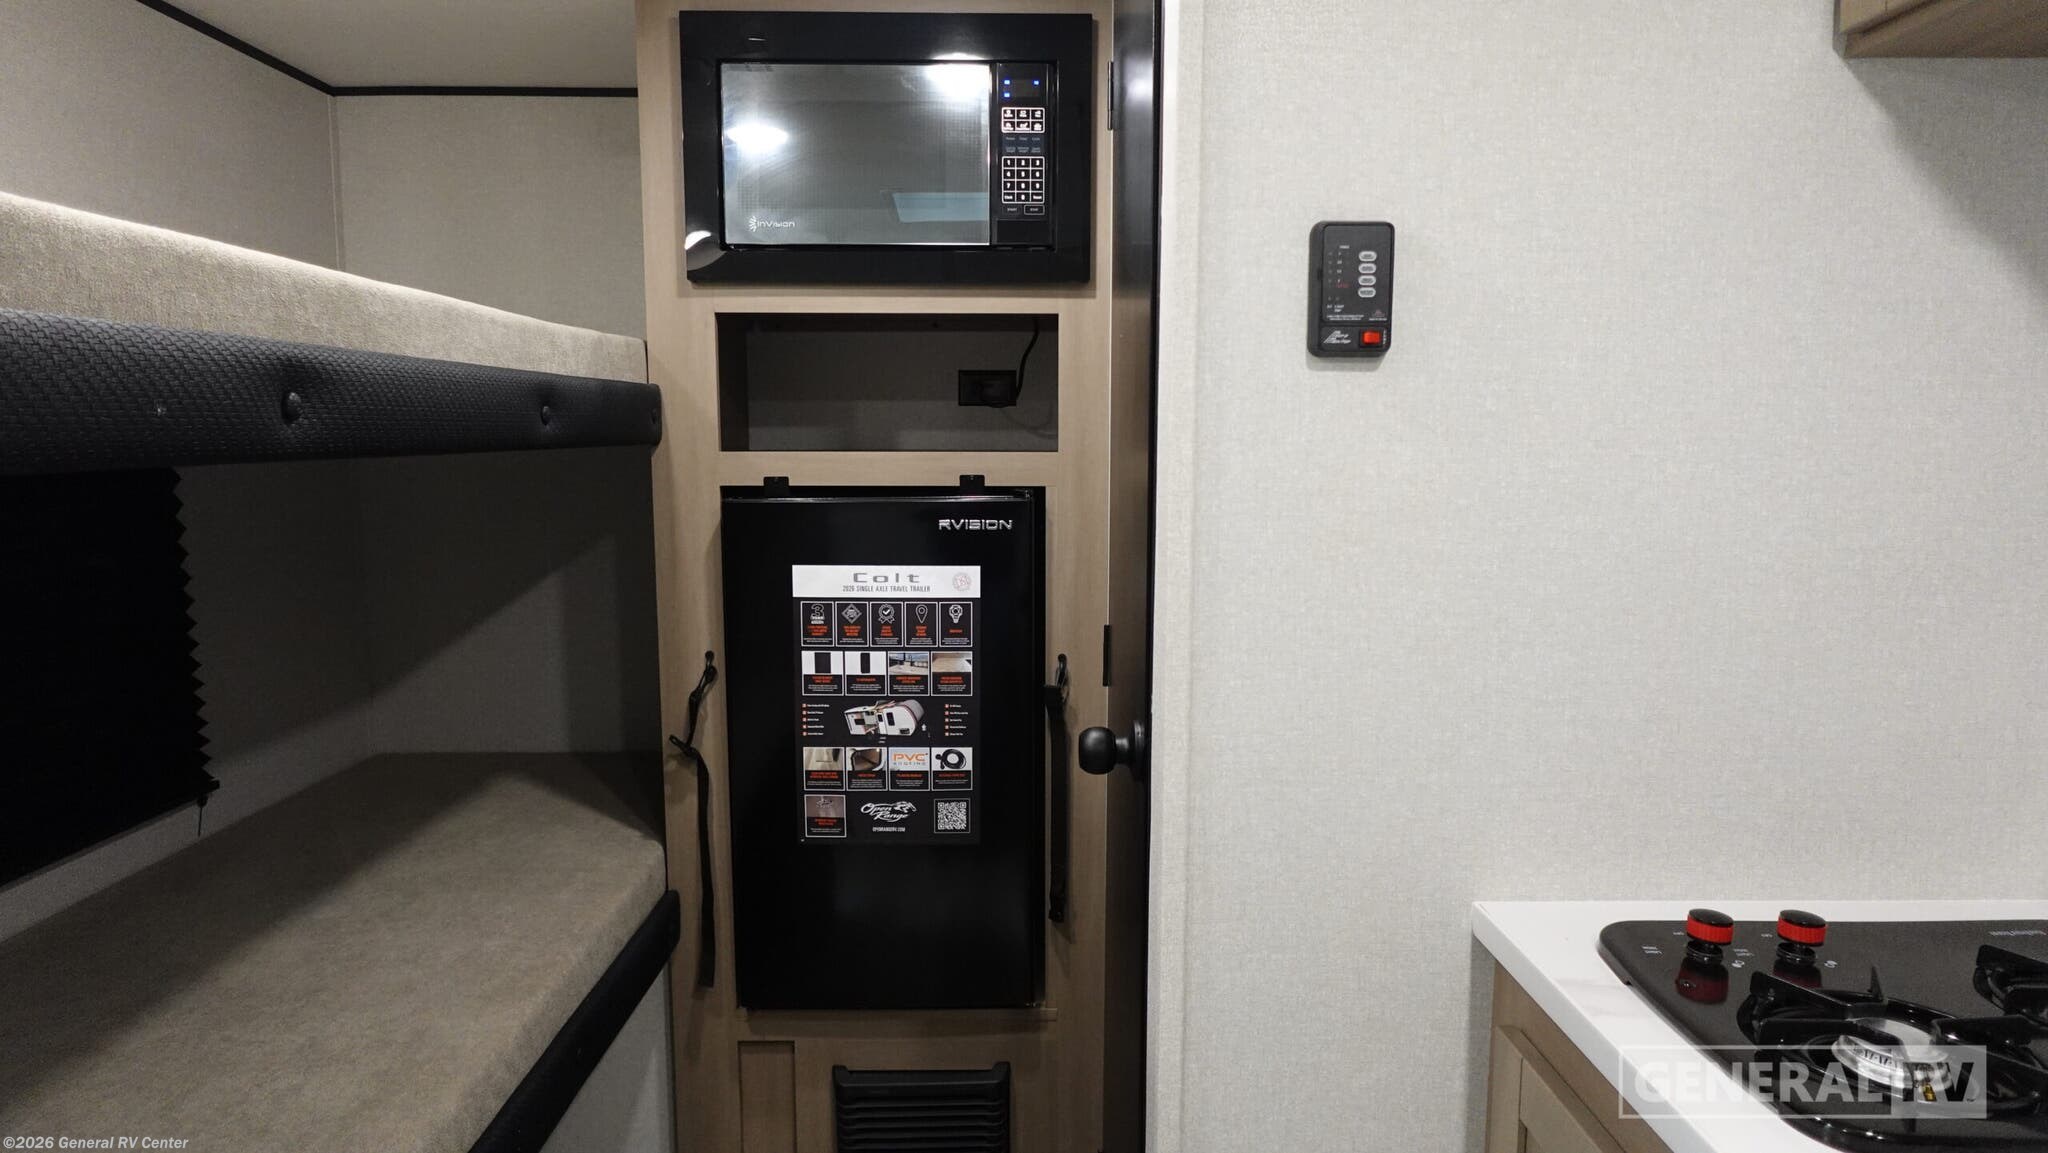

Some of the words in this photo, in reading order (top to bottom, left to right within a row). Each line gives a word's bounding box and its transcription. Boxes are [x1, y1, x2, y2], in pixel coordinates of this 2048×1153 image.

[938, 519, 1013, 531] RVISION
[853, 572, 920, 583] Colt
[893, 753, 925, 762] PVC
[861, 802, 892, 815] Open
[873, 811, 909, 822] Range
